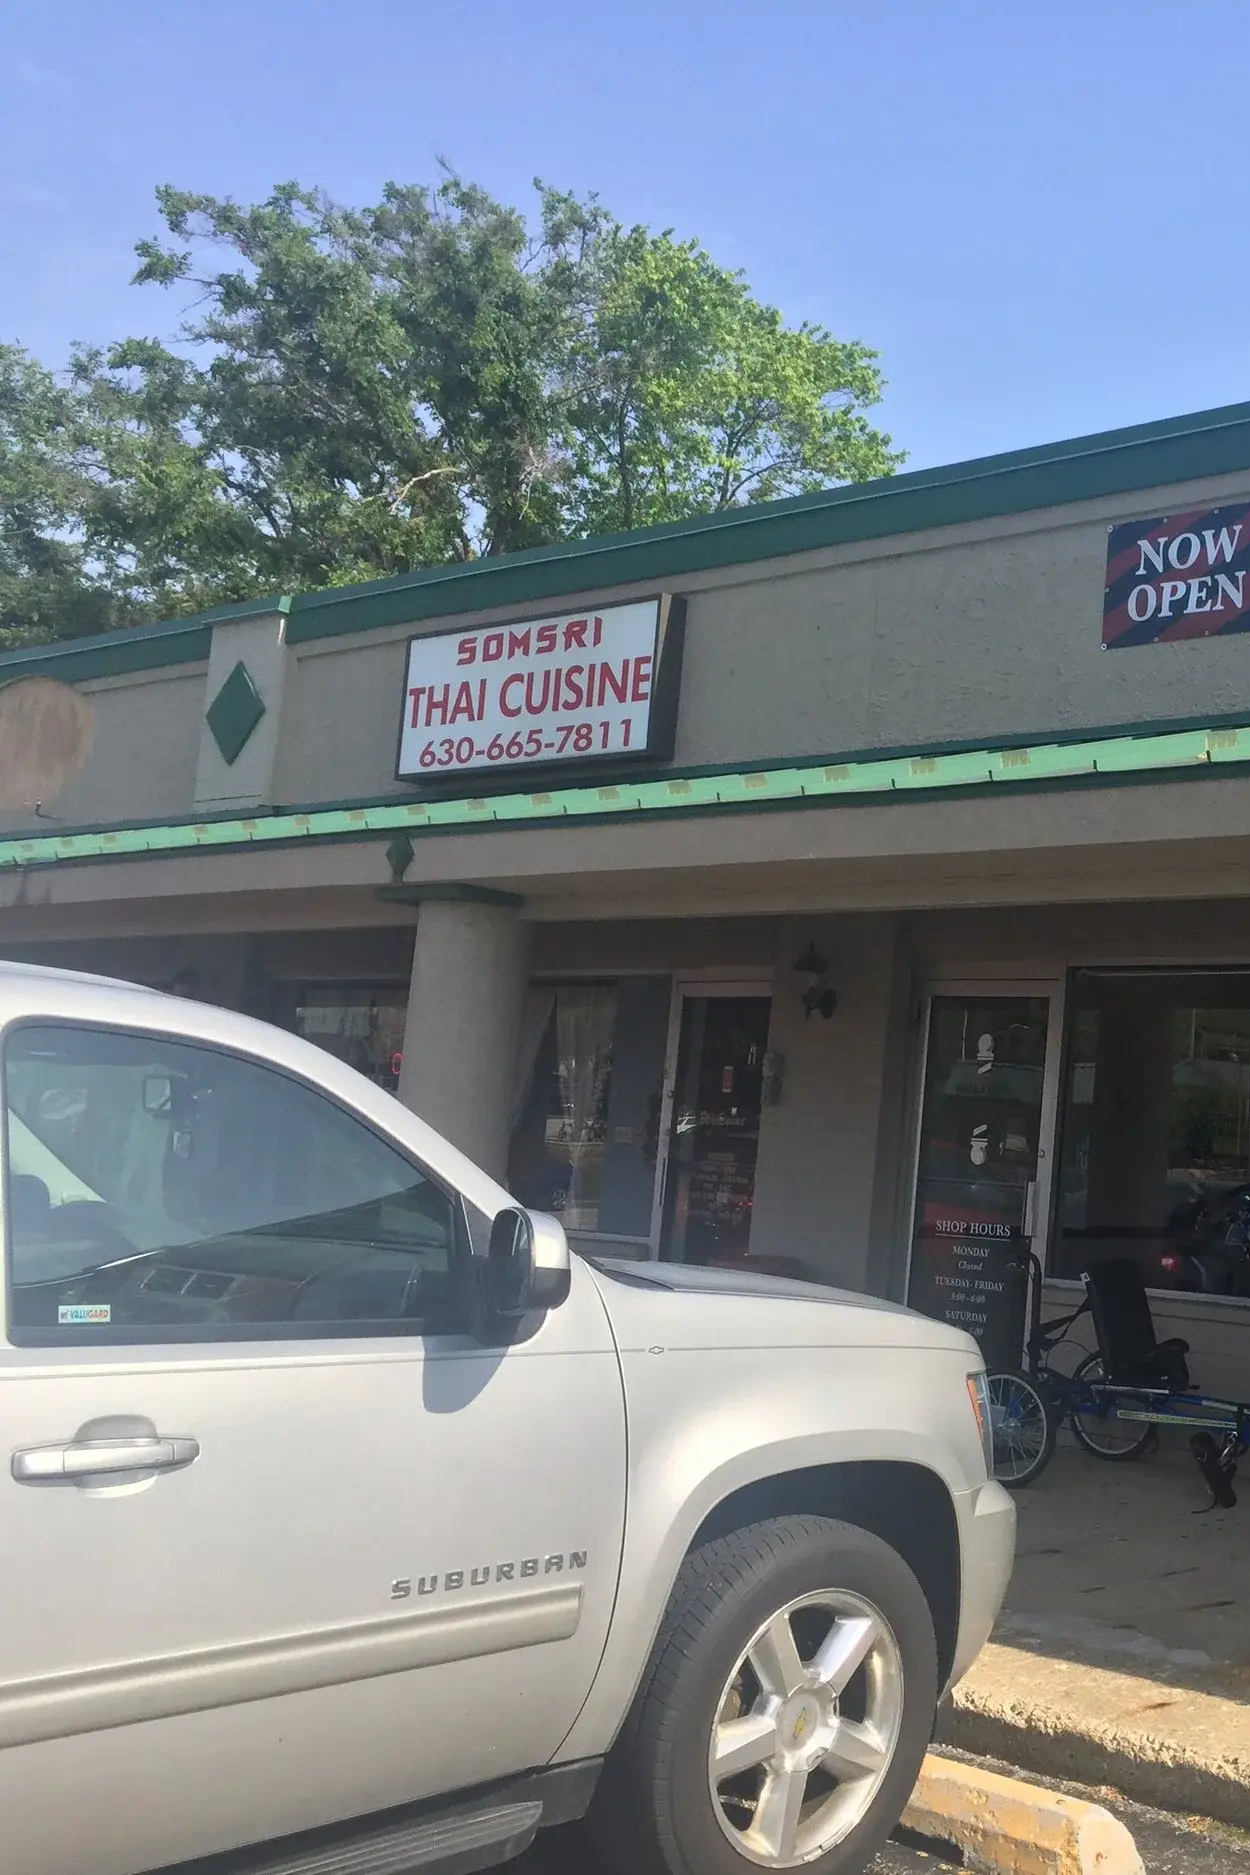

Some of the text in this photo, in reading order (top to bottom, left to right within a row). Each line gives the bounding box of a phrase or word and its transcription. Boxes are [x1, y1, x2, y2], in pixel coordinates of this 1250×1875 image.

[1135, 524, 1243, 575] NOW
[1127, 571, 1246, 622] OPEN
[456, 616, 602, 666] SOMSRI
[409, 655, 652, 729] THAI CUISINE
[419, 718, 632, 767] 630-665-7811
[935, 1220, 1011, 1237] SHOP HOURS
[952, 1245, 990, 1258] MONDAY
[958, 1260, 983, 1271] Closed
[974, 1280, 1004, 1291] FRIDAY
[945, 1311, 988, 1323] SATURDAY
[390, 1550, 587, 1600] SUBURBAN
